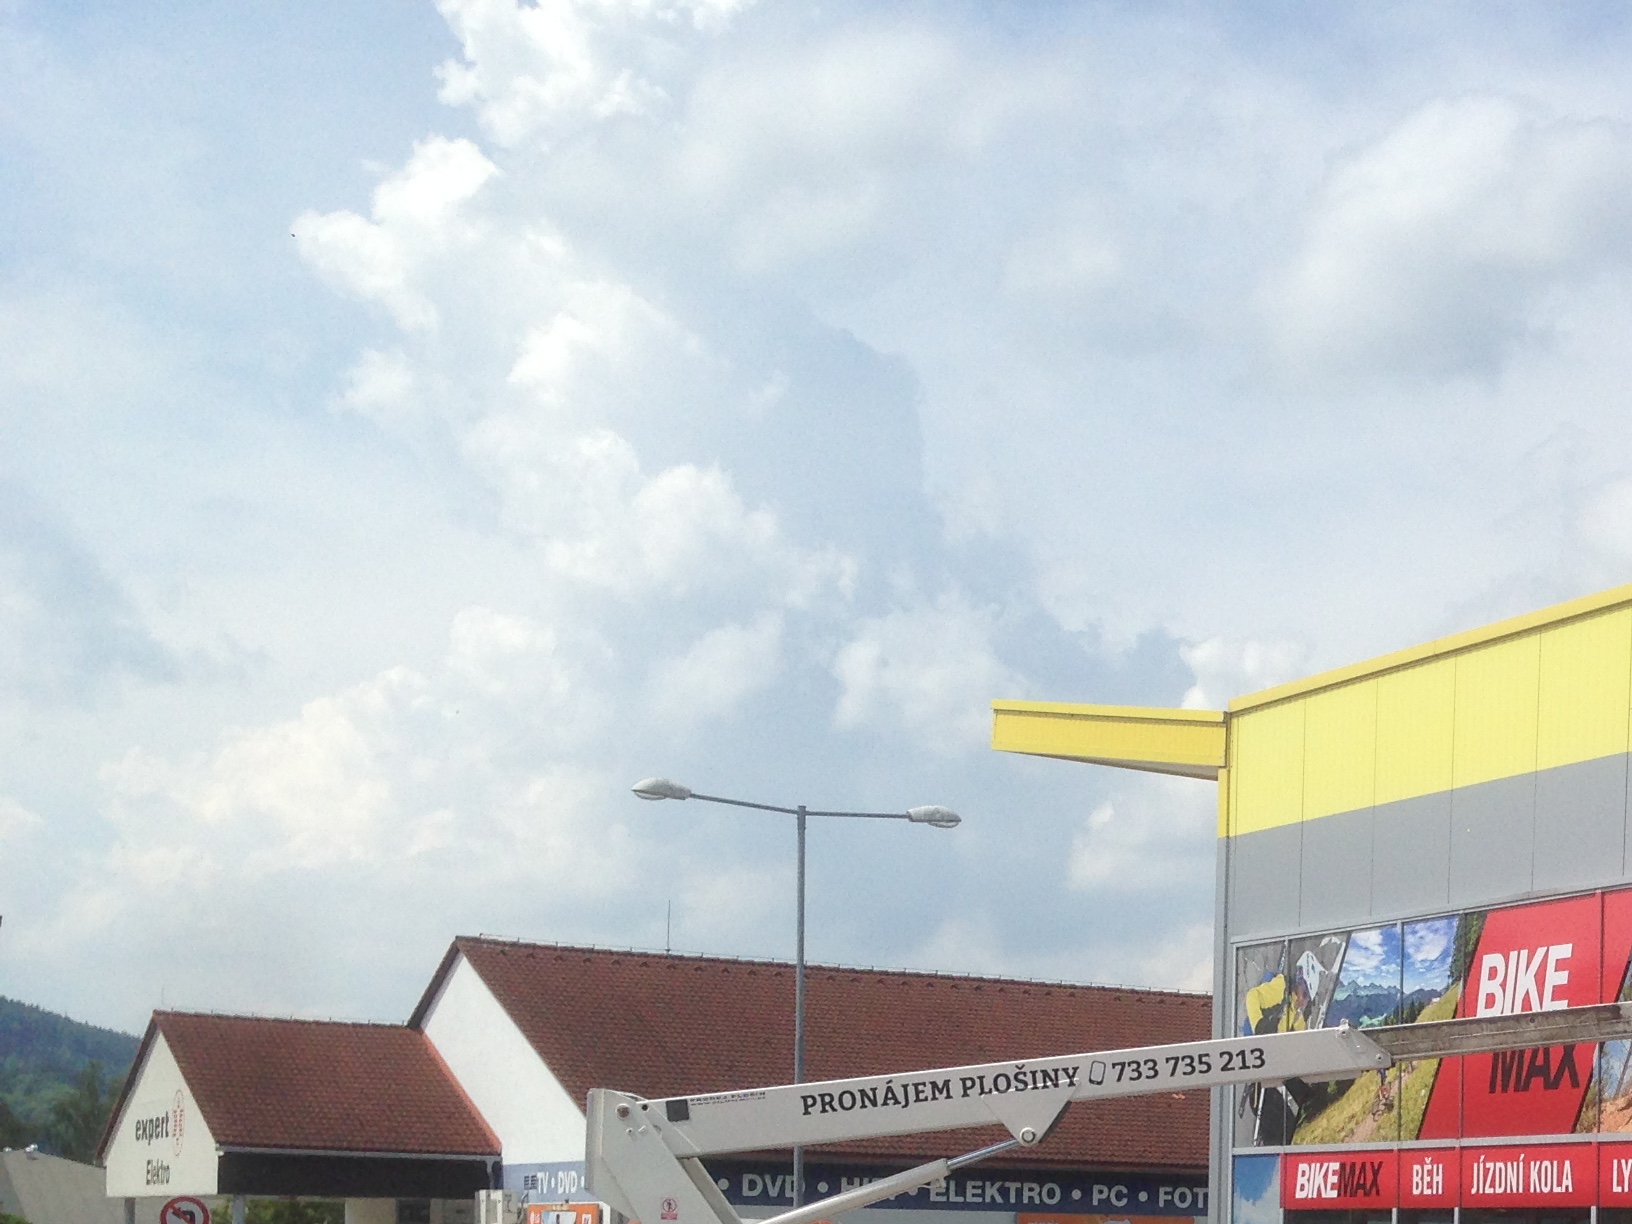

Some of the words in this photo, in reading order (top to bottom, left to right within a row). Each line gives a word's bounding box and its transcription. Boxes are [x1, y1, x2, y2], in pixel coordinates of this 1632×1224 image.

[1476, 943, 1572, 1018] BIKE
[801, 1078, 951, 1116] PRONÁJEM
[960, 1064, 1080, 1098] PLOŠINY
[1112, 1060, 1159, 1083] 733
[1165, 1053, 1212, 1077] 735
[1220, 1047, 1266, 1072] 213
[135, 1111, 169, 1146] expert
[146, 1159, 170, 1185] Elektro
[537, 1171, 549, 1194] TV
[557, 1170, 577, 1193] DVD
[1295, 1161, 1383, 1198] BIKEMAX
[1412, 1156, 1443, 1195] BĚH
[1471, 1154, 1525, 1194] JÍZDNÍ
[1530, 1160, 1573, 1193] KOLA
[930, 1179, 1061, 1205] ELEKTRO
[1092, 1184, 1129, 1207] PC
